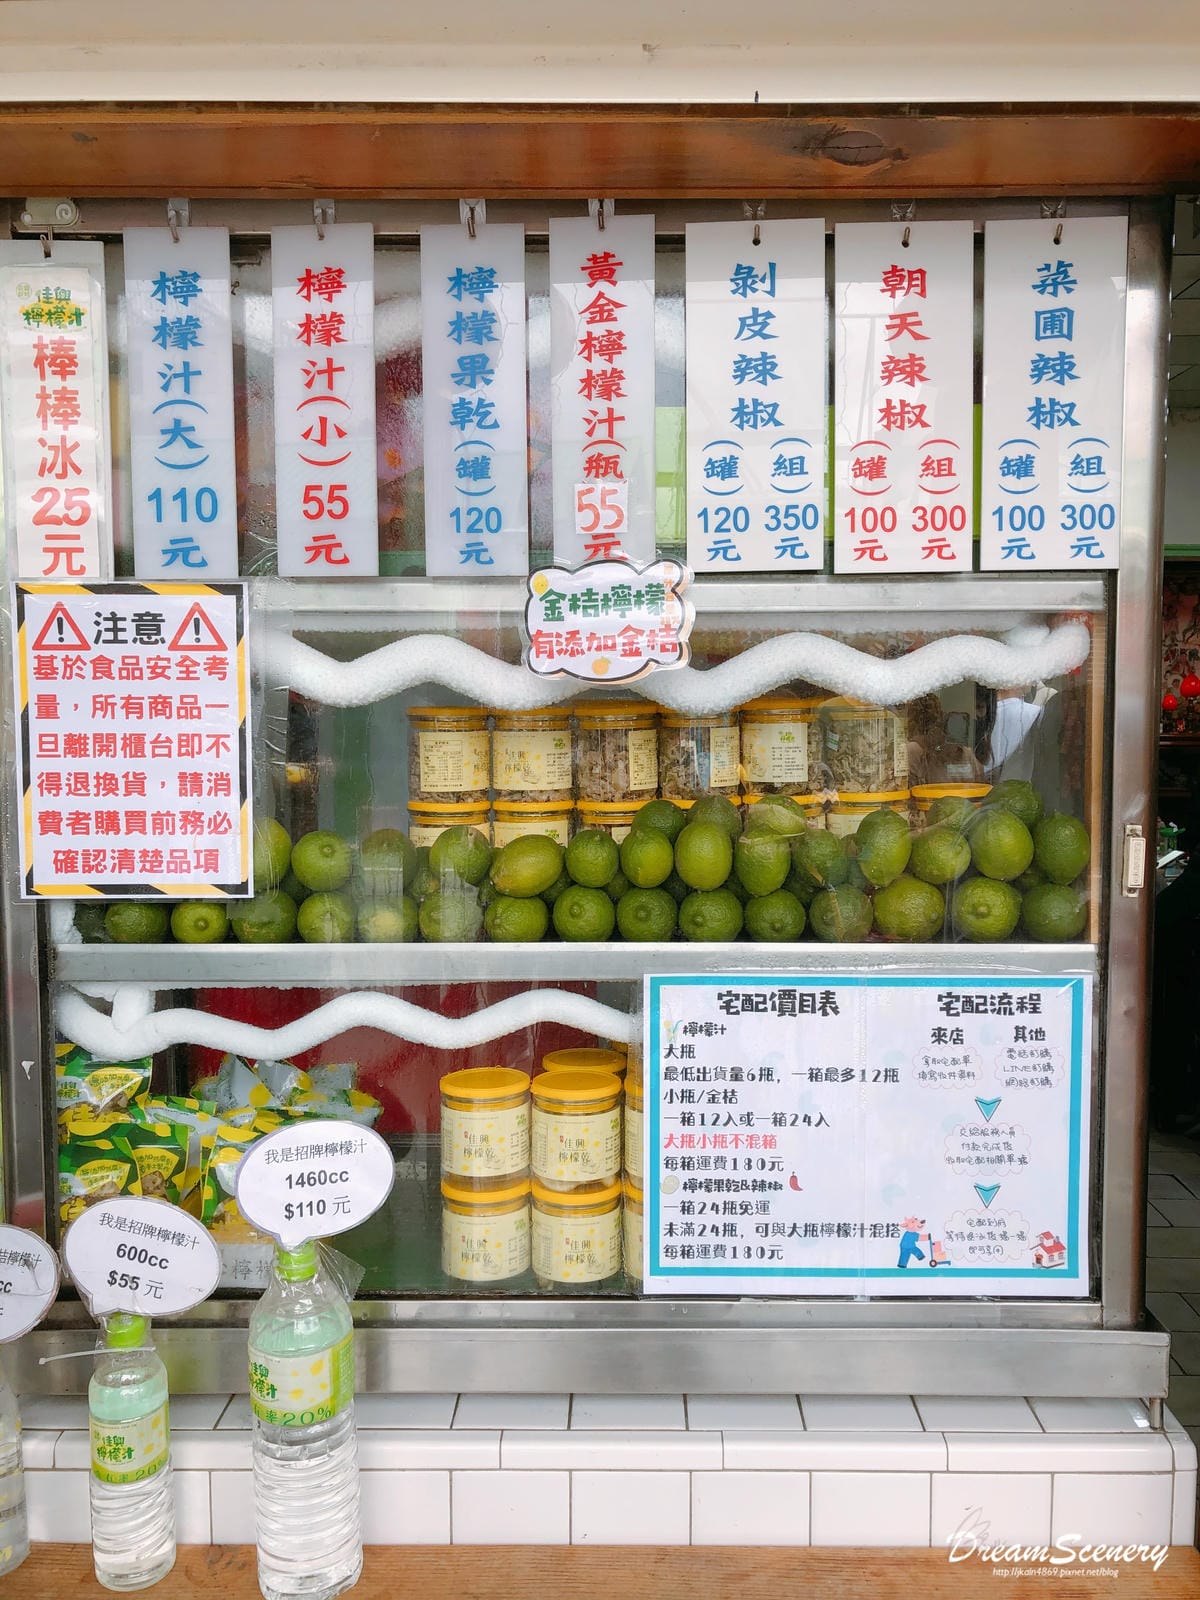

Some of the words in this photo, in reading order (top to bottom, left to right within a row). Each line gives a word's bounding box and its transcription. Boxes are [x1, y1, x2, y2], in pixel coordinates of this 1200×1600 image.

[729, 261, 784, 432] 剝皮辣椒
[876, 264, 932, 433] 朝天辣椒
[33, 335, 83, 480] 棒棒冰
[31, 486, 91, 527] 25
[147, 486, 219, 523] 110
[302, 483, 350, 521] 55
[576, 486, 626, 532] 55
[449, 506, 503, 535] 120
[697, 505, 750, 534] 120
[764, 503, 819, 532] 350
[844, 505, 898, 534] 100
[911, 504, 967, 533] 300
[991, 503, 1046, 532] 100
[1060, 503, 1116, 531] 300
[42, 533, 87, 577] 元
[161, 536, 208, 569] 元
[304, 533, 351, 565] 元
[459, 541, 495, 565] 元
[706, 538, 742, 562] 元
[773, 536, 809, 560] 元
[853, 539, 889, 562] 元
[921, 537, 957, 561] 元
[1001, 536, 1037, 560] 元
[1069, 536, 1106, 560] 元
[538, 583, 665, 622] 金桔檸檬
[93, 611, 167, 646] 注意
[531, 624, 679, 660] 有添加金桔
[32, 653, 230, 681] 基於食品安全考
[35, 732, 231, 760] 旦離開櫃台即不
[37, 809, 233, 837] 費者購買前務必
[52, 848, 221, 875] 確認清楚品項
[716, 988, 841, 1017] 宅配價目表
[937, 992, 1043, 1017] 宅配流程
[682, 1021, 728, 1038] 檸檬汁
[930, 1026, 965, 1045] 來店
[1013, 1025, 1047, 1043] 其他
[663, 1043, 697, 1060] 大瓶
[663, 1089, 739, 1105] 小瓶/金桔
[264, 1139, 368, 1165] 我是招牌檸檬汁
[663, 1133, 778, 1150] 大瓶小瓶不混箱
[663, 1156, 785, 1172] 每箱運費180元
[285, 1169, 351, 1191] 1460cc
[283, 1199, 327, 1221] $110
[332, 1195, 352, 1216] 元
[663, 1199, 772, 1216] 一箱24瓶免運
[99, 1211, 201, 1251] 我是招牌檸檬汁
[116, 1243, 171, 1271] 600cc
[663, 1244, 784, 1261] 每箱運費180元
[107, 1269, 141, 1292] $55
[145, 1279, 165, 1300] 元
